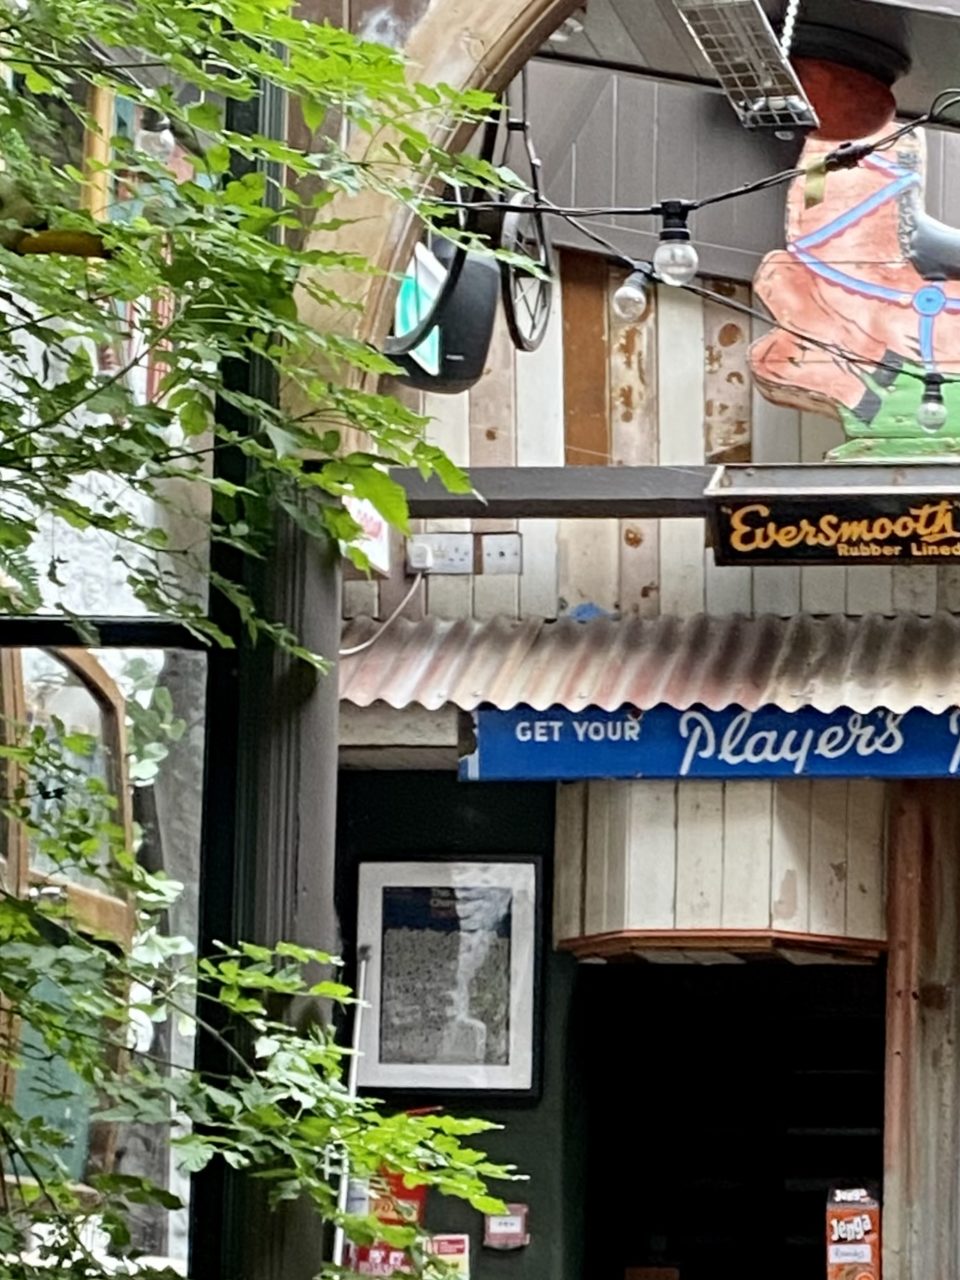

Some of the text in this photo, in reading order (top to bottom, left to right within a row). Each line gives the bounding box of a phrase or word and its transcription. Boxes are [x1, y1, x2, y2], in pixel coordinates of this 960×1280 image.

[838, 543, 902, 556] Rubber
[515, 721, 562, 741] GET
[573, 721, 641, 741] YOUR
[830, 1214, 872, 1241] Jenga
